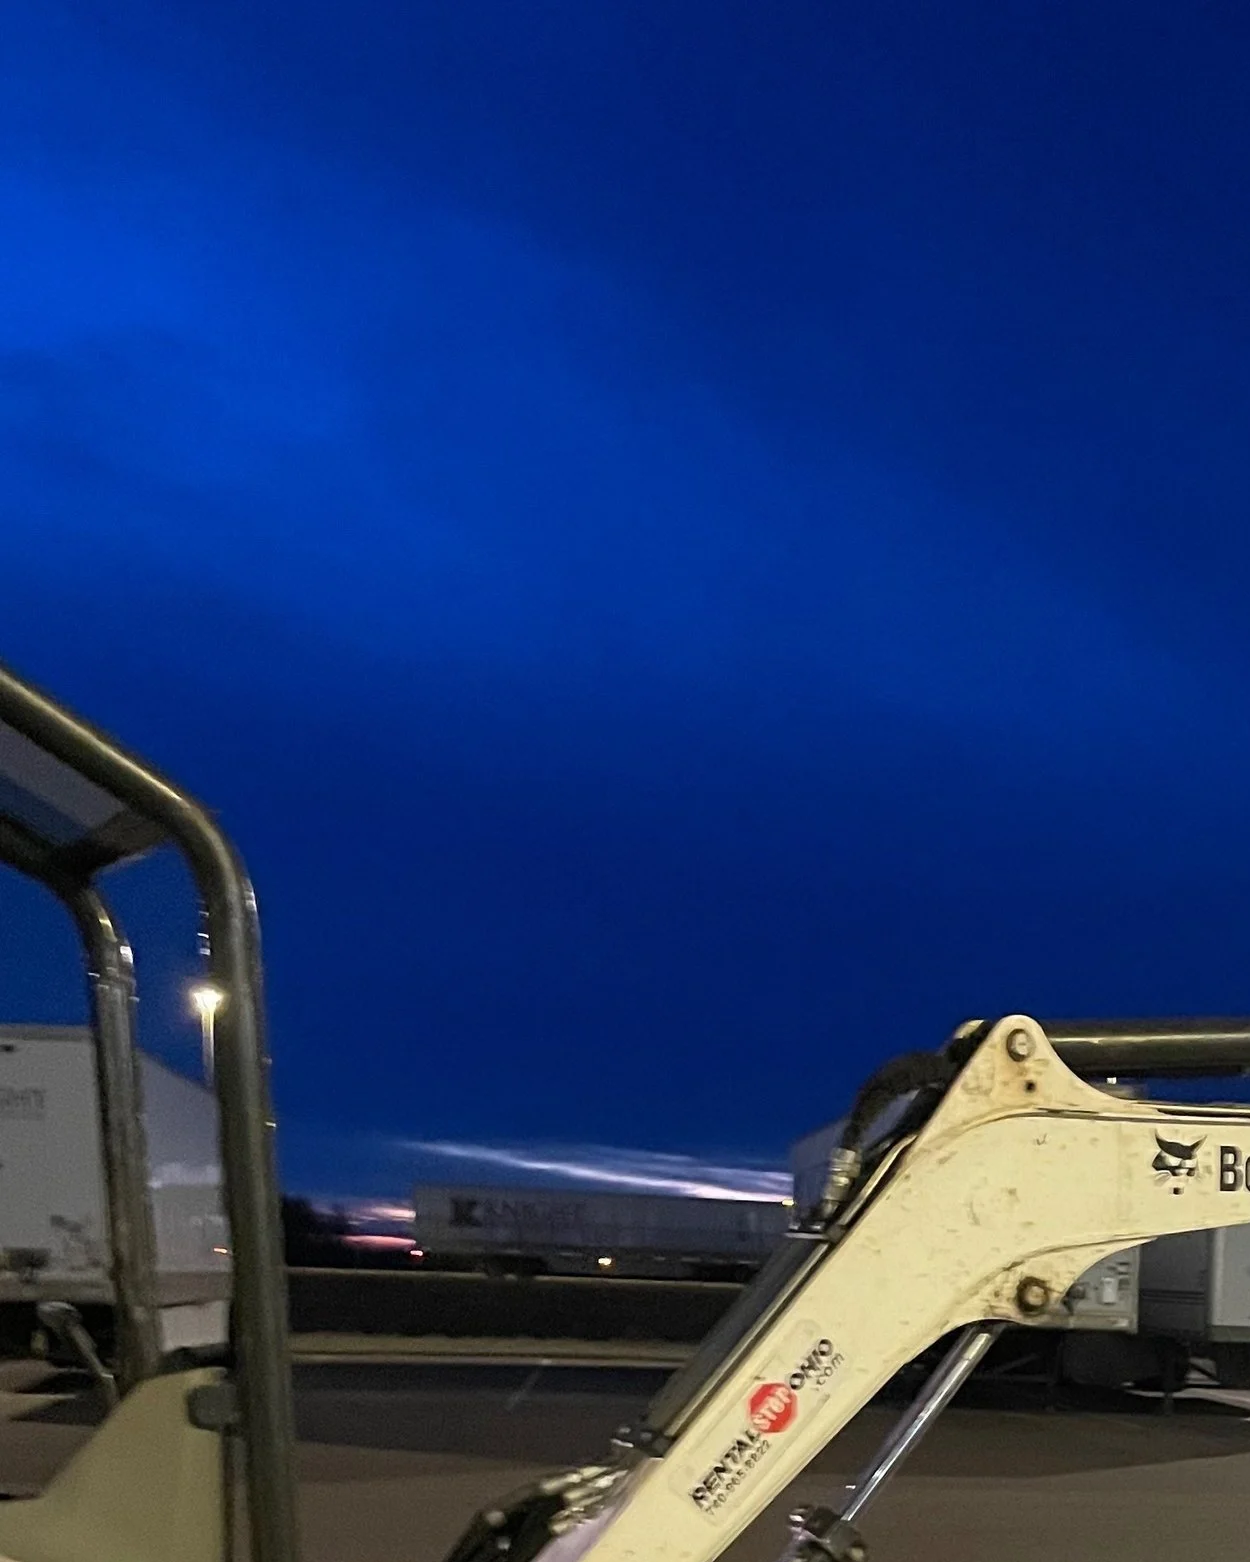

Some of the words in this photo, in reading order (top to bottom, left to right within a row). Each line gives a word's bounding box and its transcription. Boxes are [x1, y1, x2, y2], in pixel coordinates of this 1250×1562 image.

[689, 1430, 761, 1508] RENTAL
[752, 1385, 792, 1431] STOP
[789, 1338, 833, 1391] OHIO
